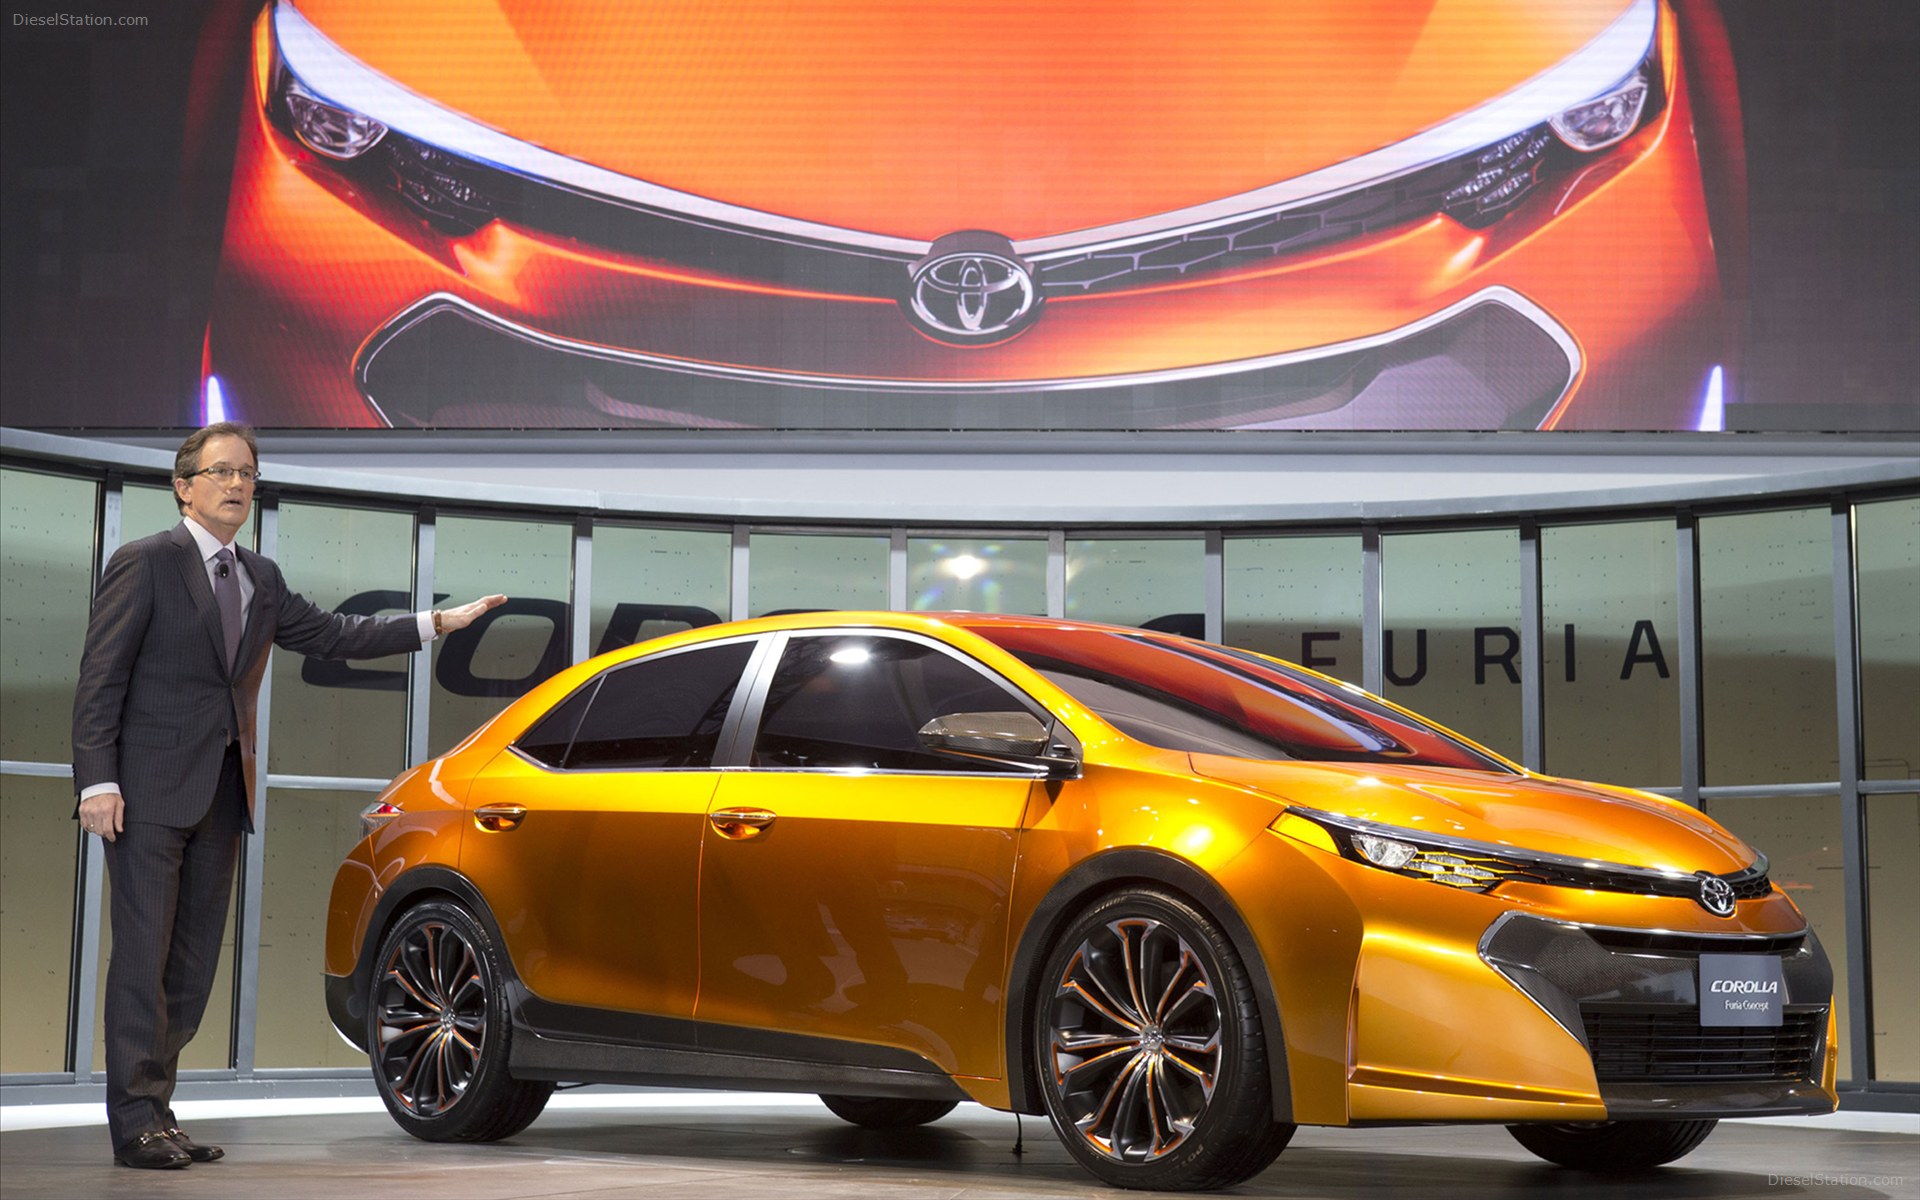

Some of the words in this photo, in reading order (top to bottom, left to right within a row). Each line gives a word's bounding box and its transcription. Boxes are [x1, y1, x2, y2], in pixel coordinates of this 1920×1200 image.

[1710, 980, 1778, 994] COROLLA
[1725, 1000, 1742, 1010] Furia
[1743, 1000, 1769, 1012] Concept
